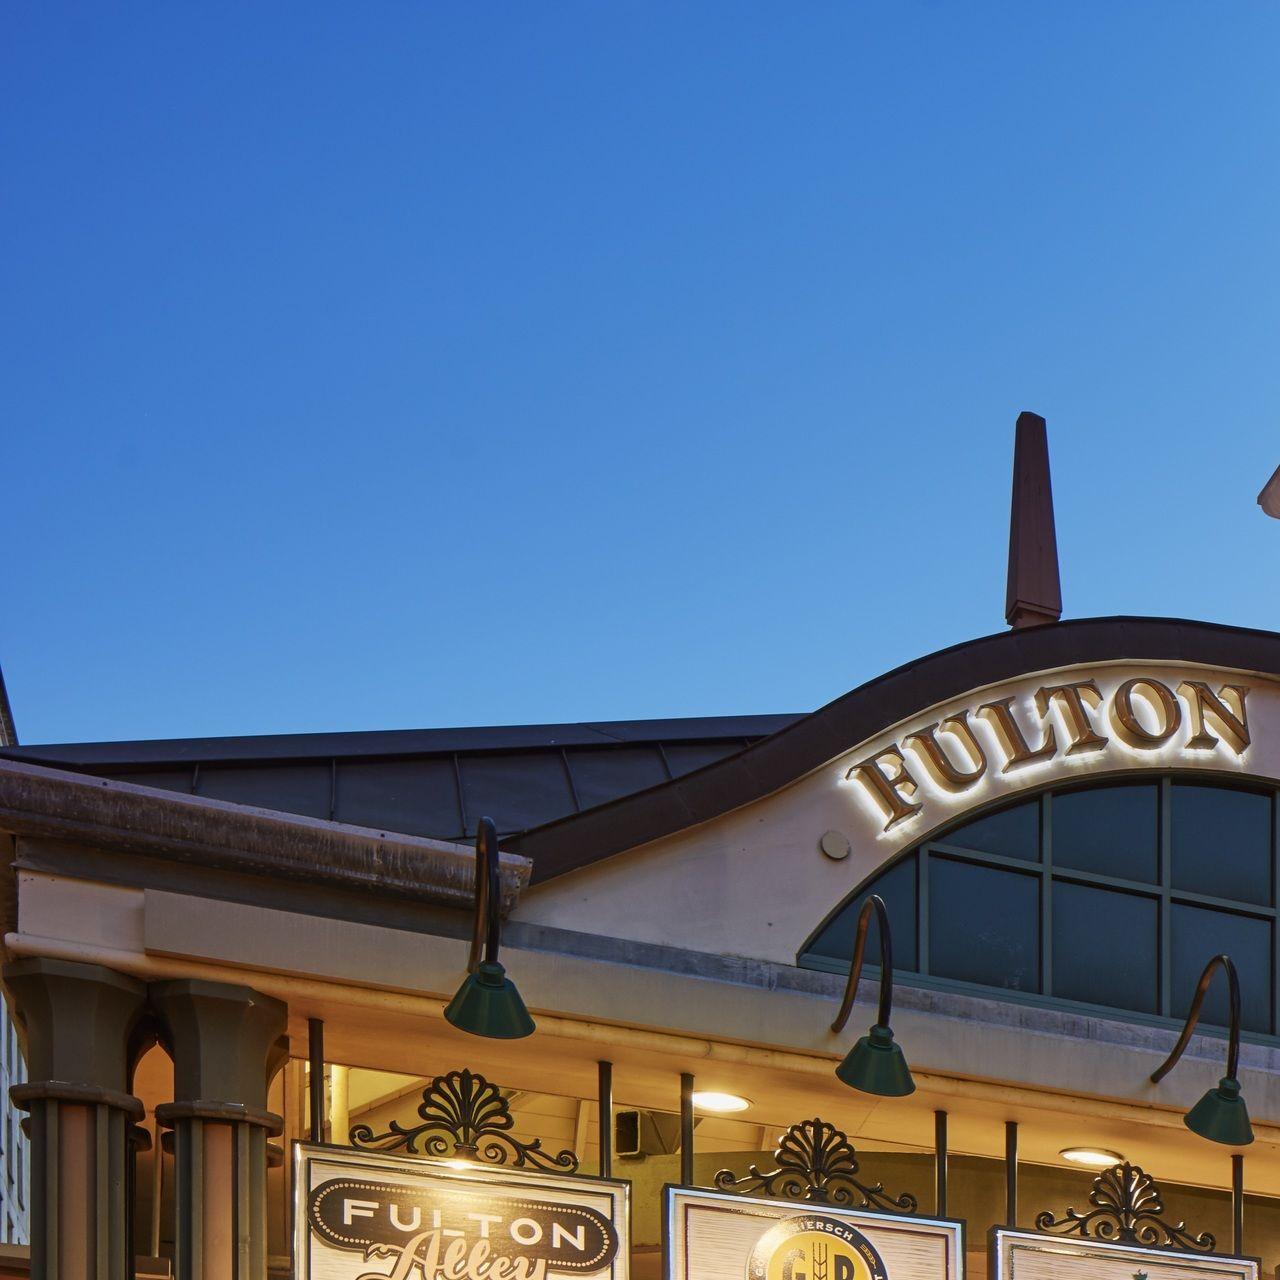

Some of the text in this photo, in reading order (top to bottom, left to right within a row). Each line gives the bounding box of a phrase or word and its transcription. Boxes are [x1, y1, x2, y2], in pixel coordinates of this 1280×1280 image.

[845, 676, 1250, 832] FULTON
[343, 1198, 585, 1251] FULTON
[799, 1220, 854, 1241] IERSCH
